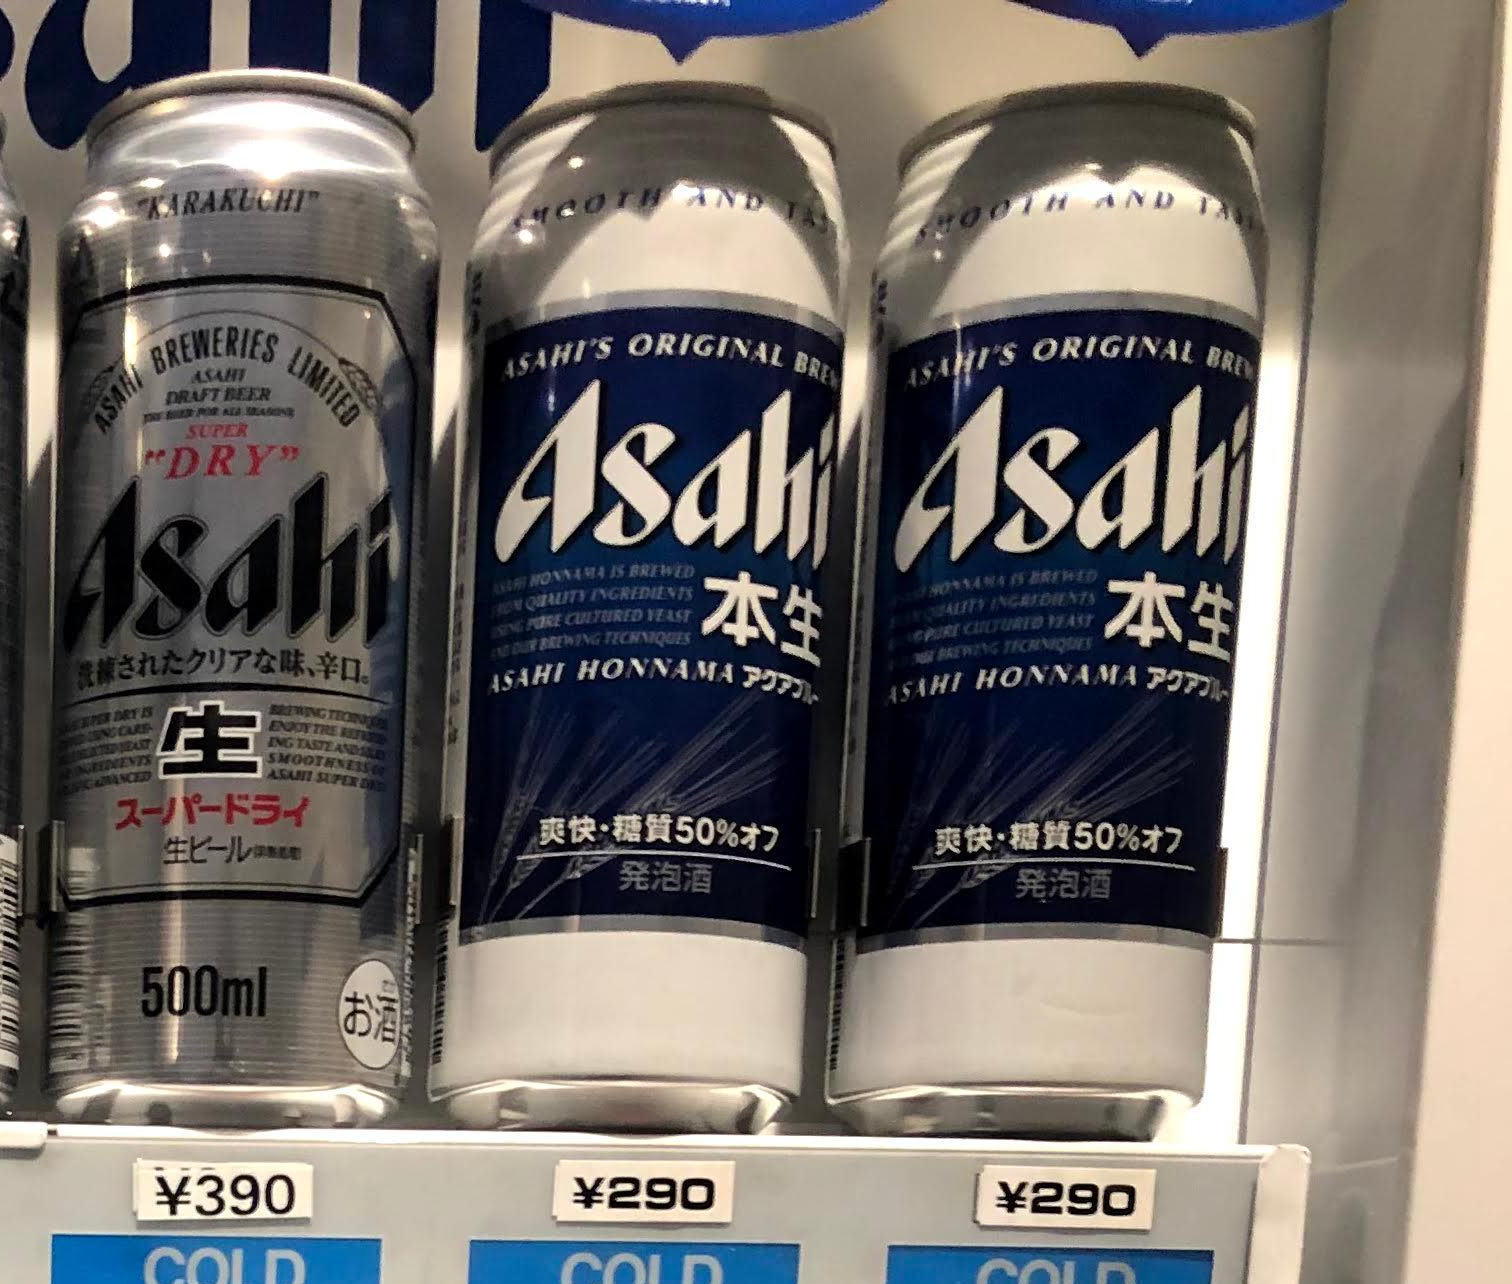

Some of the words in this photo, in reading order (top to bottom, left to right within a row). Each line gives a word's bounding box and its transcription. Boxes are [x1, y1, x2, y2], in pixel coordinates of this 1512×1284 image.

[150, 325, 280, 376] BREWERIES
[288, 346, 362, 428] LIMITED
[502, 336, 614, 382] ASAHI'S
[628, 332, 784, 369] ORIGINAL
[904, 337, 1018, 390] ASAHI'S
[1032, 334, 1194, 366] ORIGINAL
[186, 422, 249, 439] SUPER
[493, 379, 835, 571] Asahi
[894, 384, 1251, 574] Asahi
[61, 471, 392, 656] Asahi
[700, 571, 824, 668] 本生
[1104, 571, 1235, 664] 本生
[487, 662, 565, 696] ASAHI
[577, 657, 733, 686] HONNAMA
[888, 672, 963, 706] ASAHI
[976, 664, 1138, 690] HONNAMA
[156, 699, 263, 780] 生
[114, 793, 310, 830] スーパードライ
[619, 860, 713, 895] 発泡酒
[1015, 868, 1113, 900] 発泡酒
[141, 965, 269, 1018] 500ml
[155, 1172, 297, 1217] ¥390
[573, 1176, 716, 1212] ¥290
[996, 1180, 1138, 1218] ¥290
